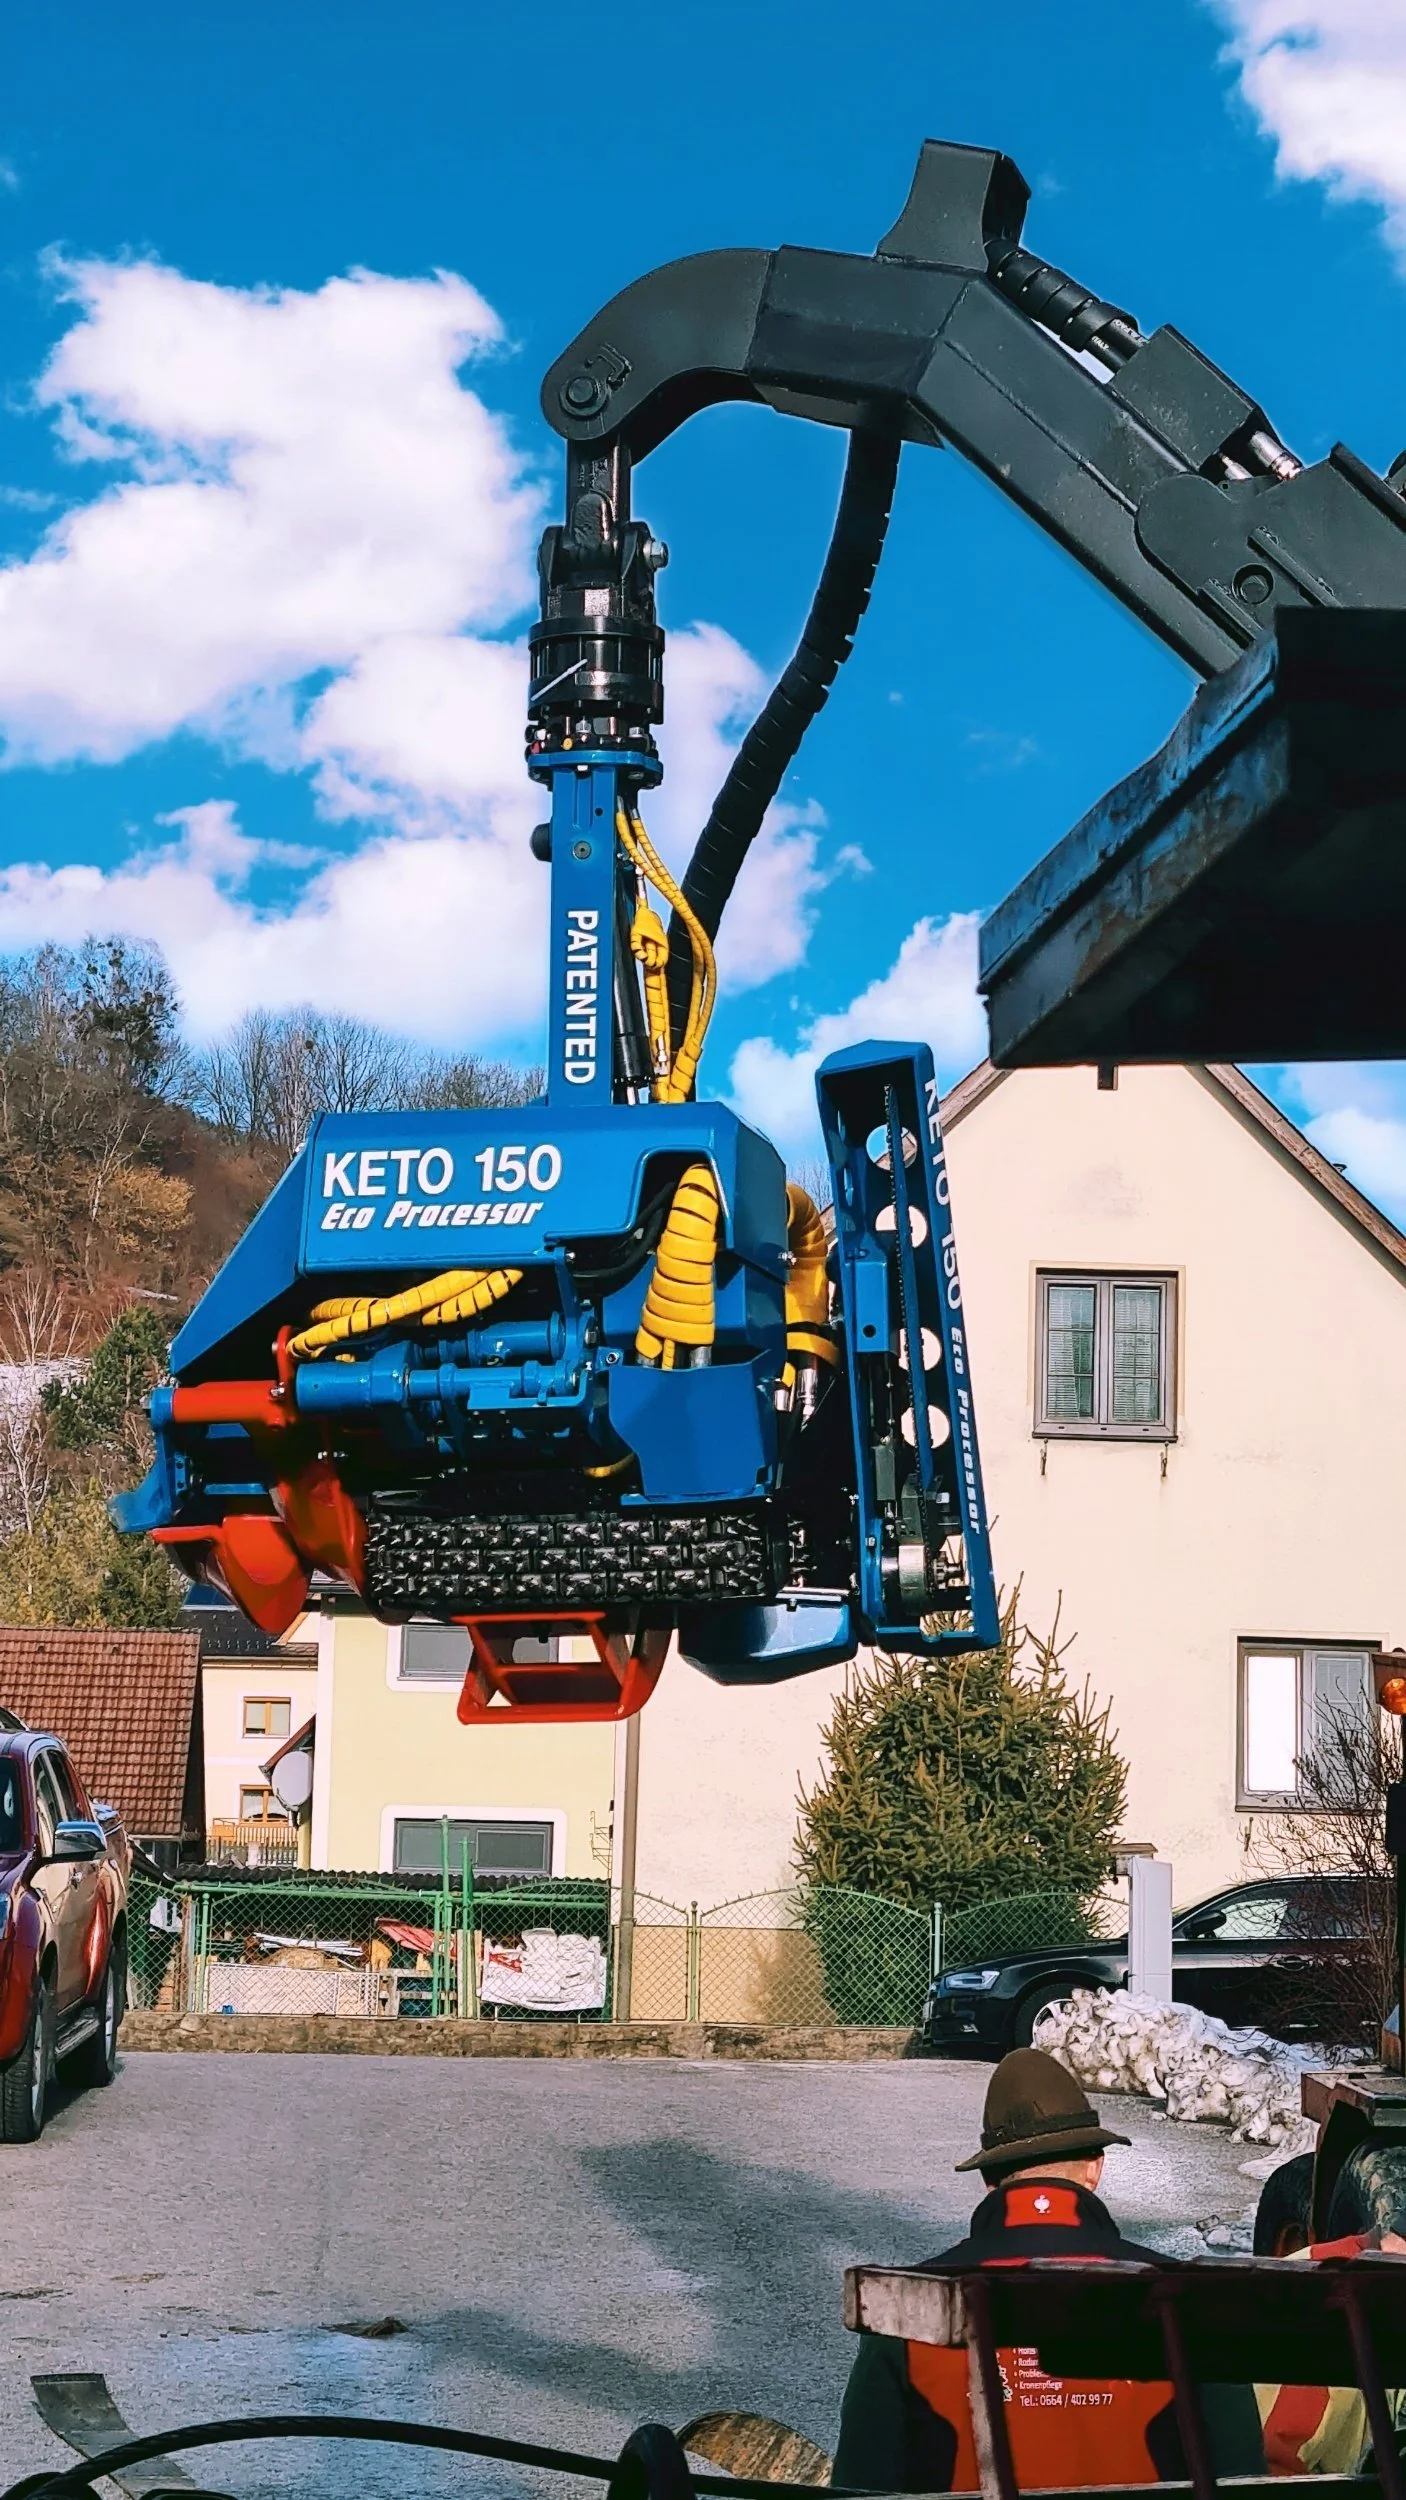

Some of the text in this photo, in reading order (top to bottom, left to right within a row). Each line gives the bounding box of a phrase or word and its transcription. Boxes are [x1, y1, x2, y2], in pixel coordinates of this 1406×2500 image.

[564, 910, 599, 1084] PATENTED
[321, 1144, 562, 1198] KETO 150
[320, 1199, 544, 1231] Eco Processor
[942, 1222, 963, 1310] 150
[951, 1327, 980, 1535] Eco Processor
[1040, 2394, 1063, 2406] 0664
[1071, 2393, 1087, 2406] 402
[1088, 2393, 1100, 2405] 99
[1102, 2393, 1113, 2405] 77
